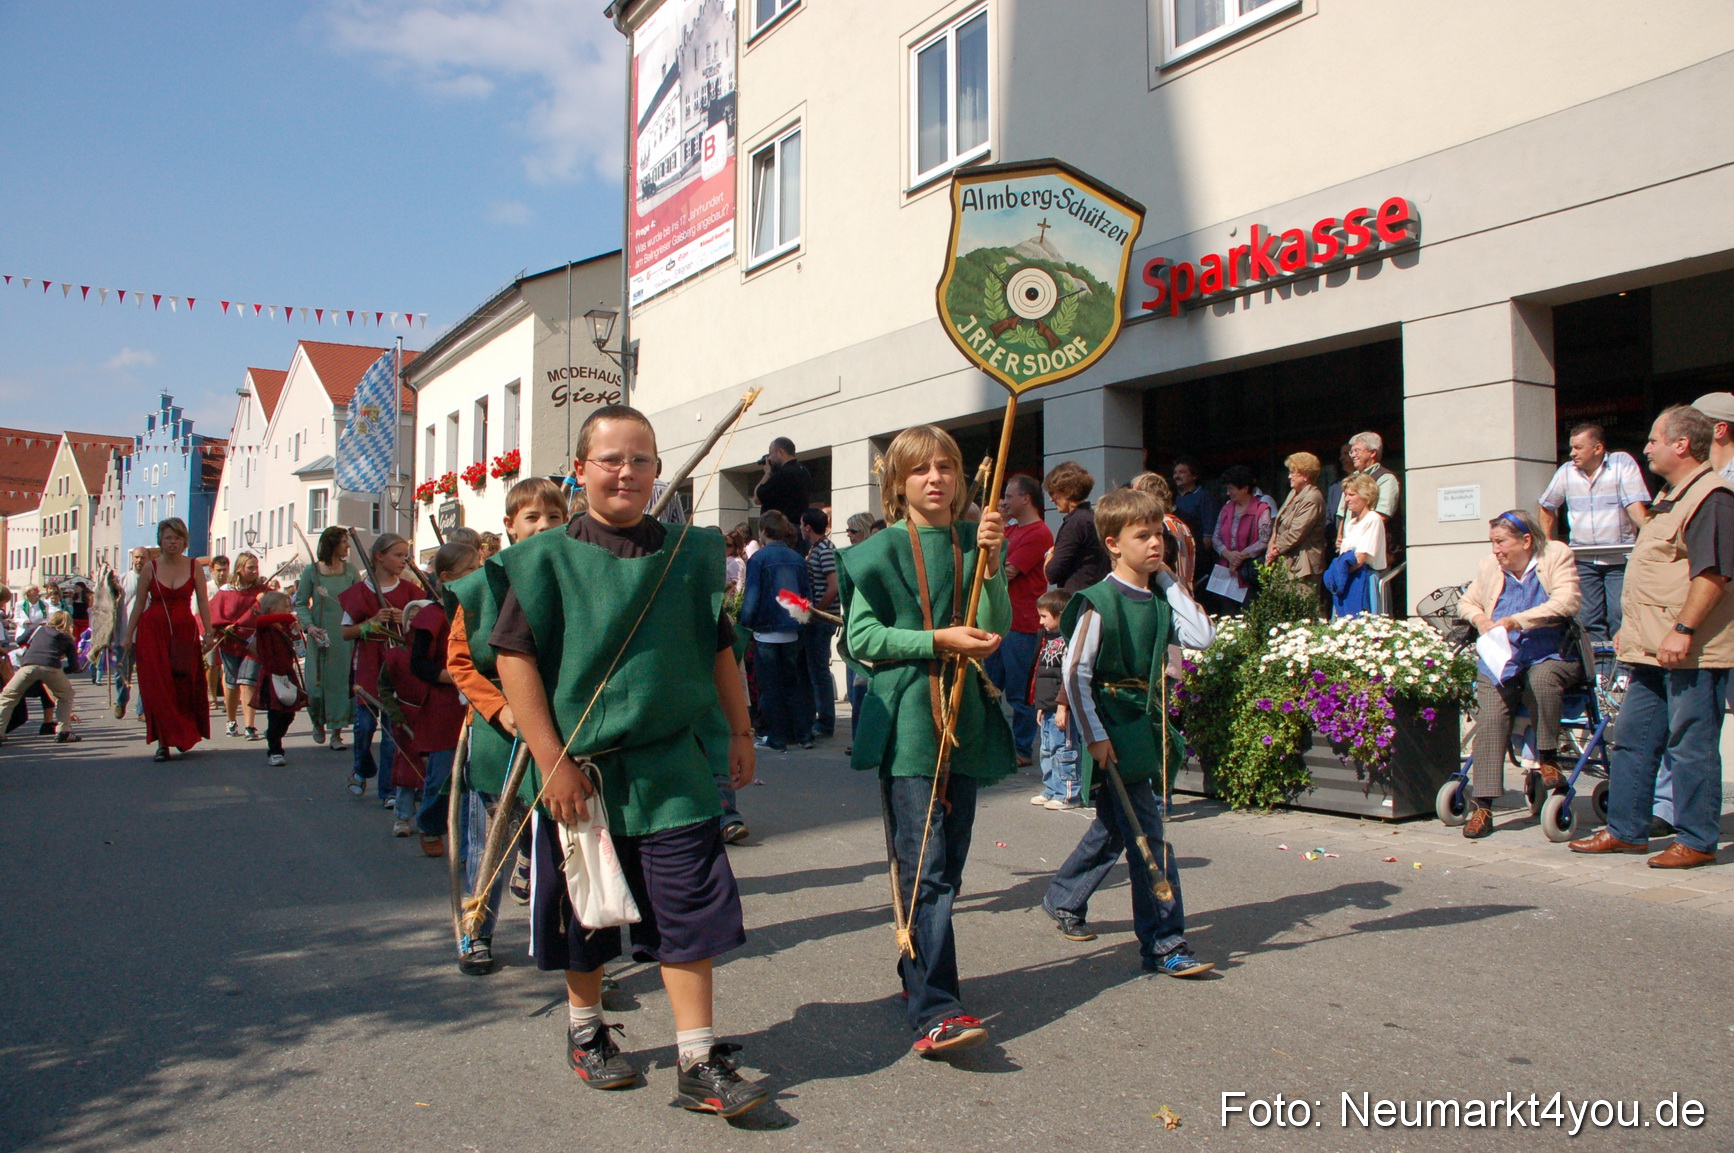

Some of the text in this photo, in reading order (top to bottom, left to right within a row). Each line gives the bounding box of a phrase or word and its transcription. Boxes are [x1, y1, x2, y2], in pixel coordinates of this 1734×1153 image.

[704, 133, 716, 163] B
[635, 243, 647, 255] Was
[647, 231, 663, 248] wurde
[662, 225, 671, 238] bis
[671, 220, 680, 233] ins
[687, 192, 724, 222] Jahrhundert
[635, 226, 650, 239] Frage
[635, 258, 644, 269] am
[672, 227, 697, 246] Gaisberg
[696, 203, 730, 233] angebaut?
[961, 184, 1129, 246] Almberg-Schützen
[1141, 195, 1413, 317] Sparkasse
[547, 366, 622, 387] MODEHAUS
